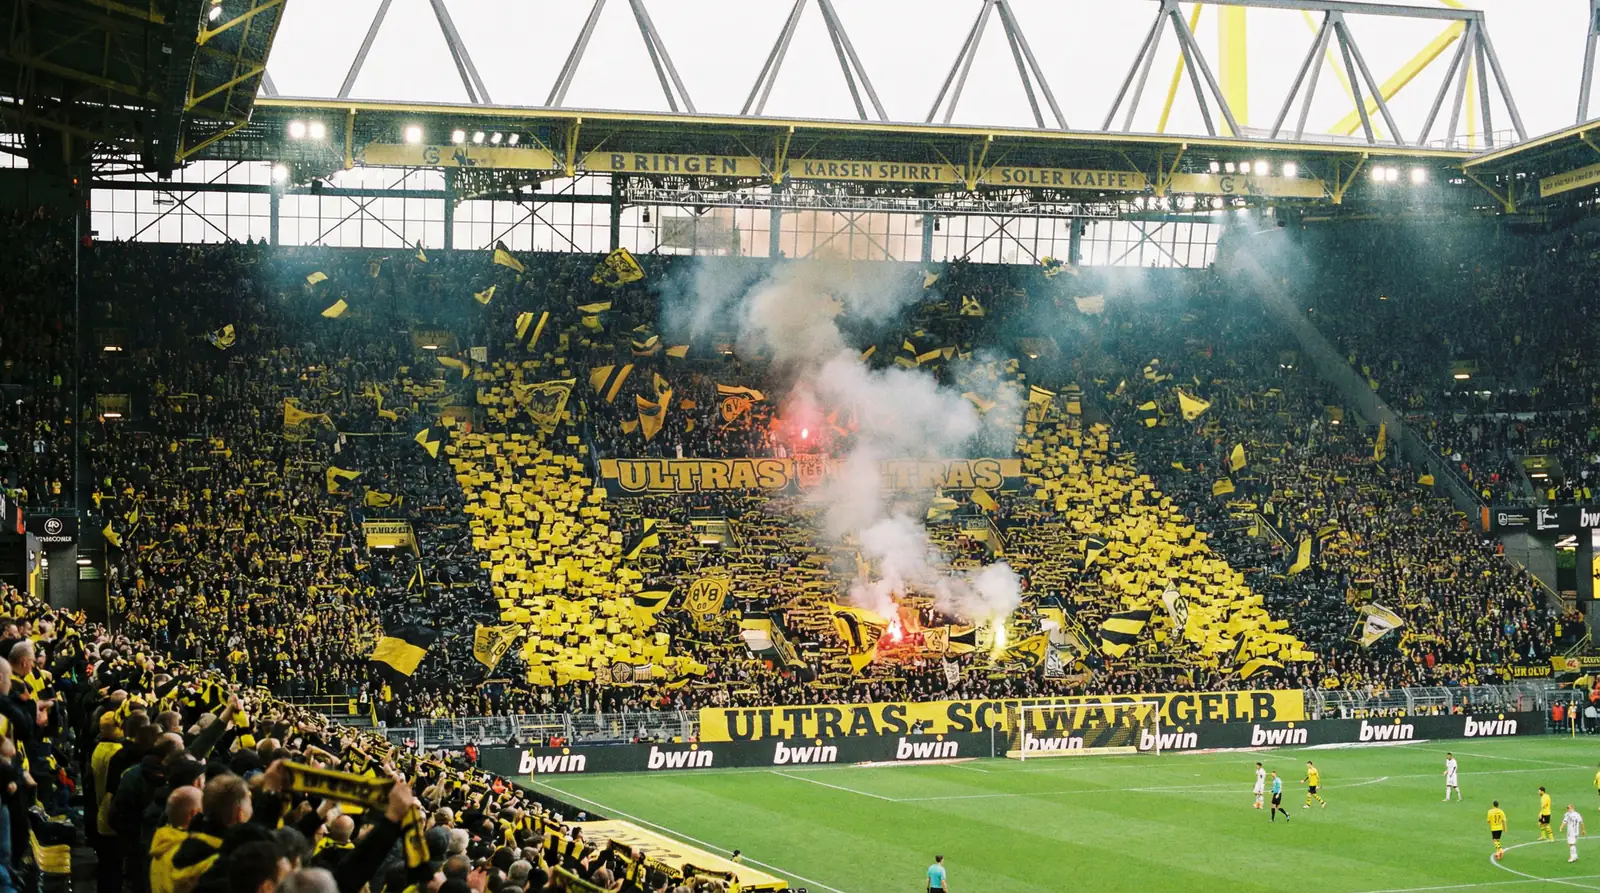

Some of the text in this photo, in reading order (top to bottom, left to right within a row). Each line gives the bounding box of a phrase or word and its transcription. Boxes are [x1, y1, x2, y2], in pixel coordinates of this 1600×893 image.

[804, 162, 942, 180] KARSEN SPIRRT
[1002, 168, 1127, 187] SOLER KAFFE
[617, 459, 788, 493] ULTRAS
[725, 704, 909, 741] ULTRAS
[947, 693, 1277, 733] SCHWARZGELB
[1359, 717, 1414, 741] bwin
[1464, 713, 1517, 736] bwin
[1023, 730, 1083, 751] bwin
[1139, 726, 1198, 750] bwin
[1251, 722, 1308, 745] bwin
[648, 744, 713, 769] bwin
[773, 739, 838, 764] bwin
[897, 734, 959, 759] bwin
[519, 747, 586, 773] bwin
